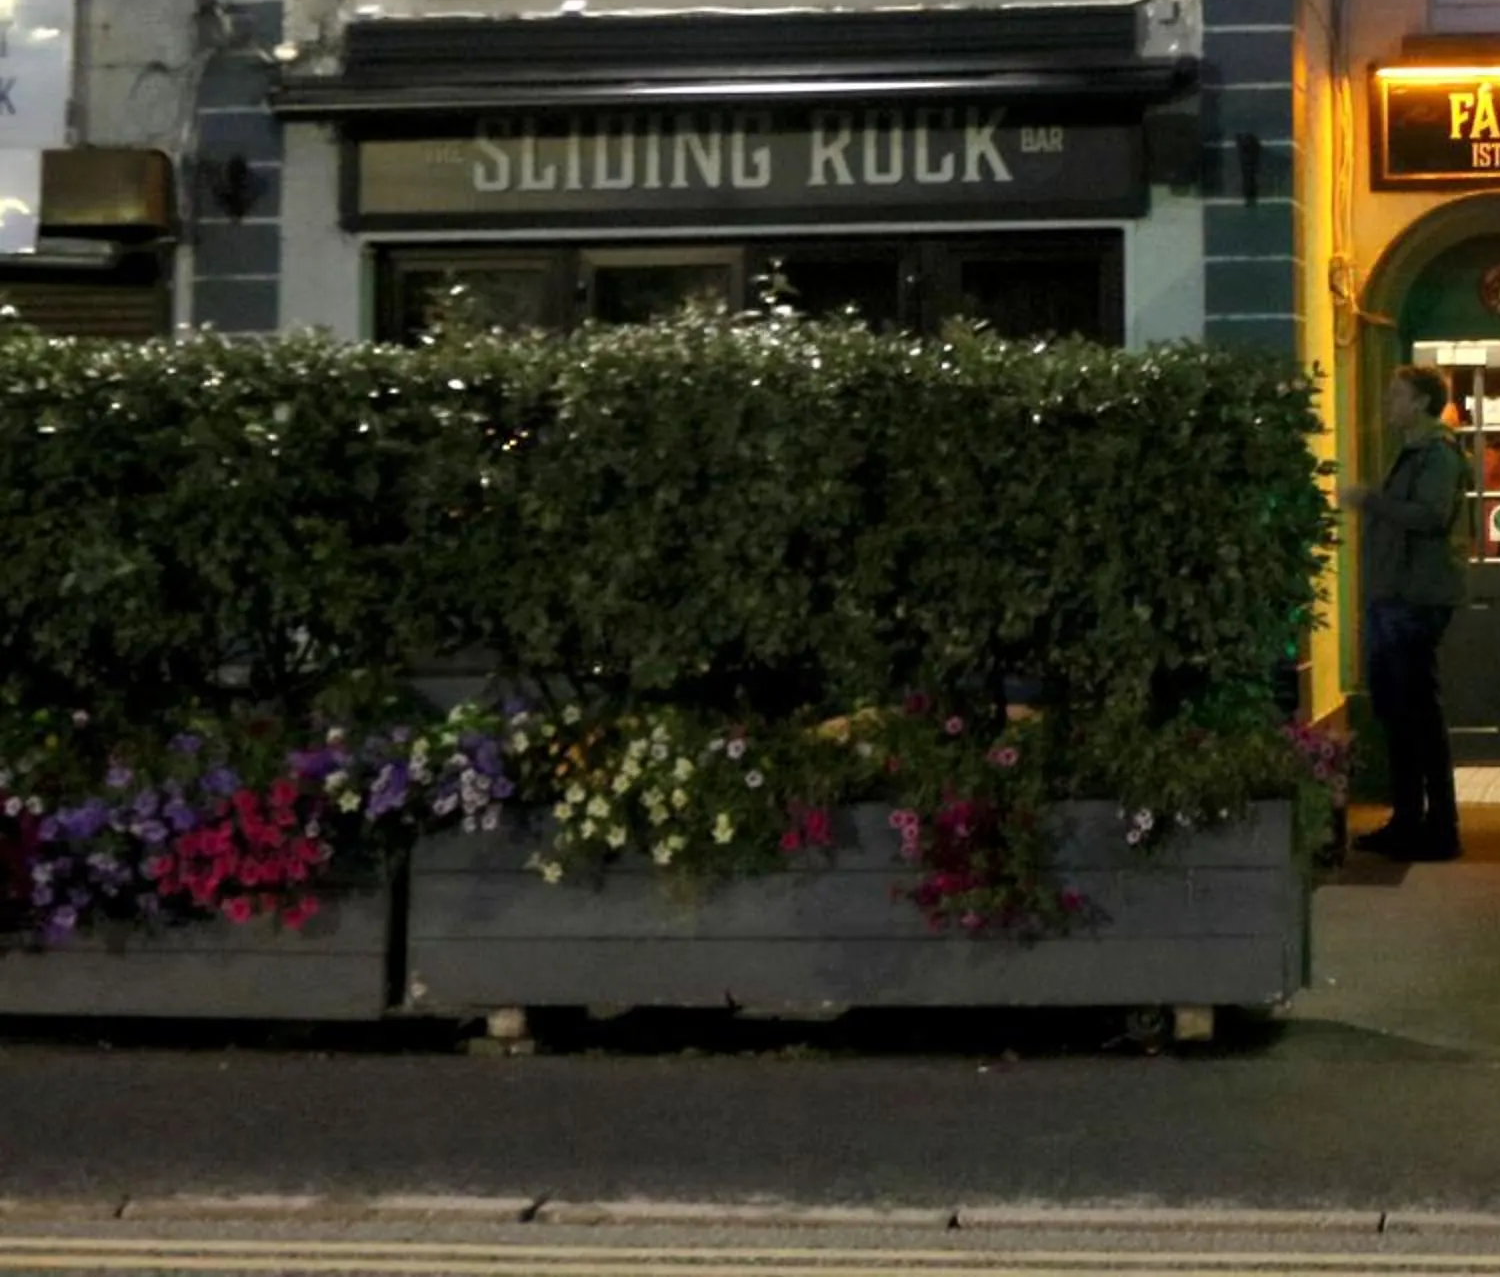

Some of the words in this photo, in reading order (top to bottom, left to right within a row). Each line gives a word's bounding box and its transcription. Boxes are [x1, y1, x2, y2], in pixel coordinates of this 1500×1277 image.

[472, 112, 773, 191] SLIDING
[804, 106, 1014, 186] ROCK
[1019, 126, 1063, 153] BAR
